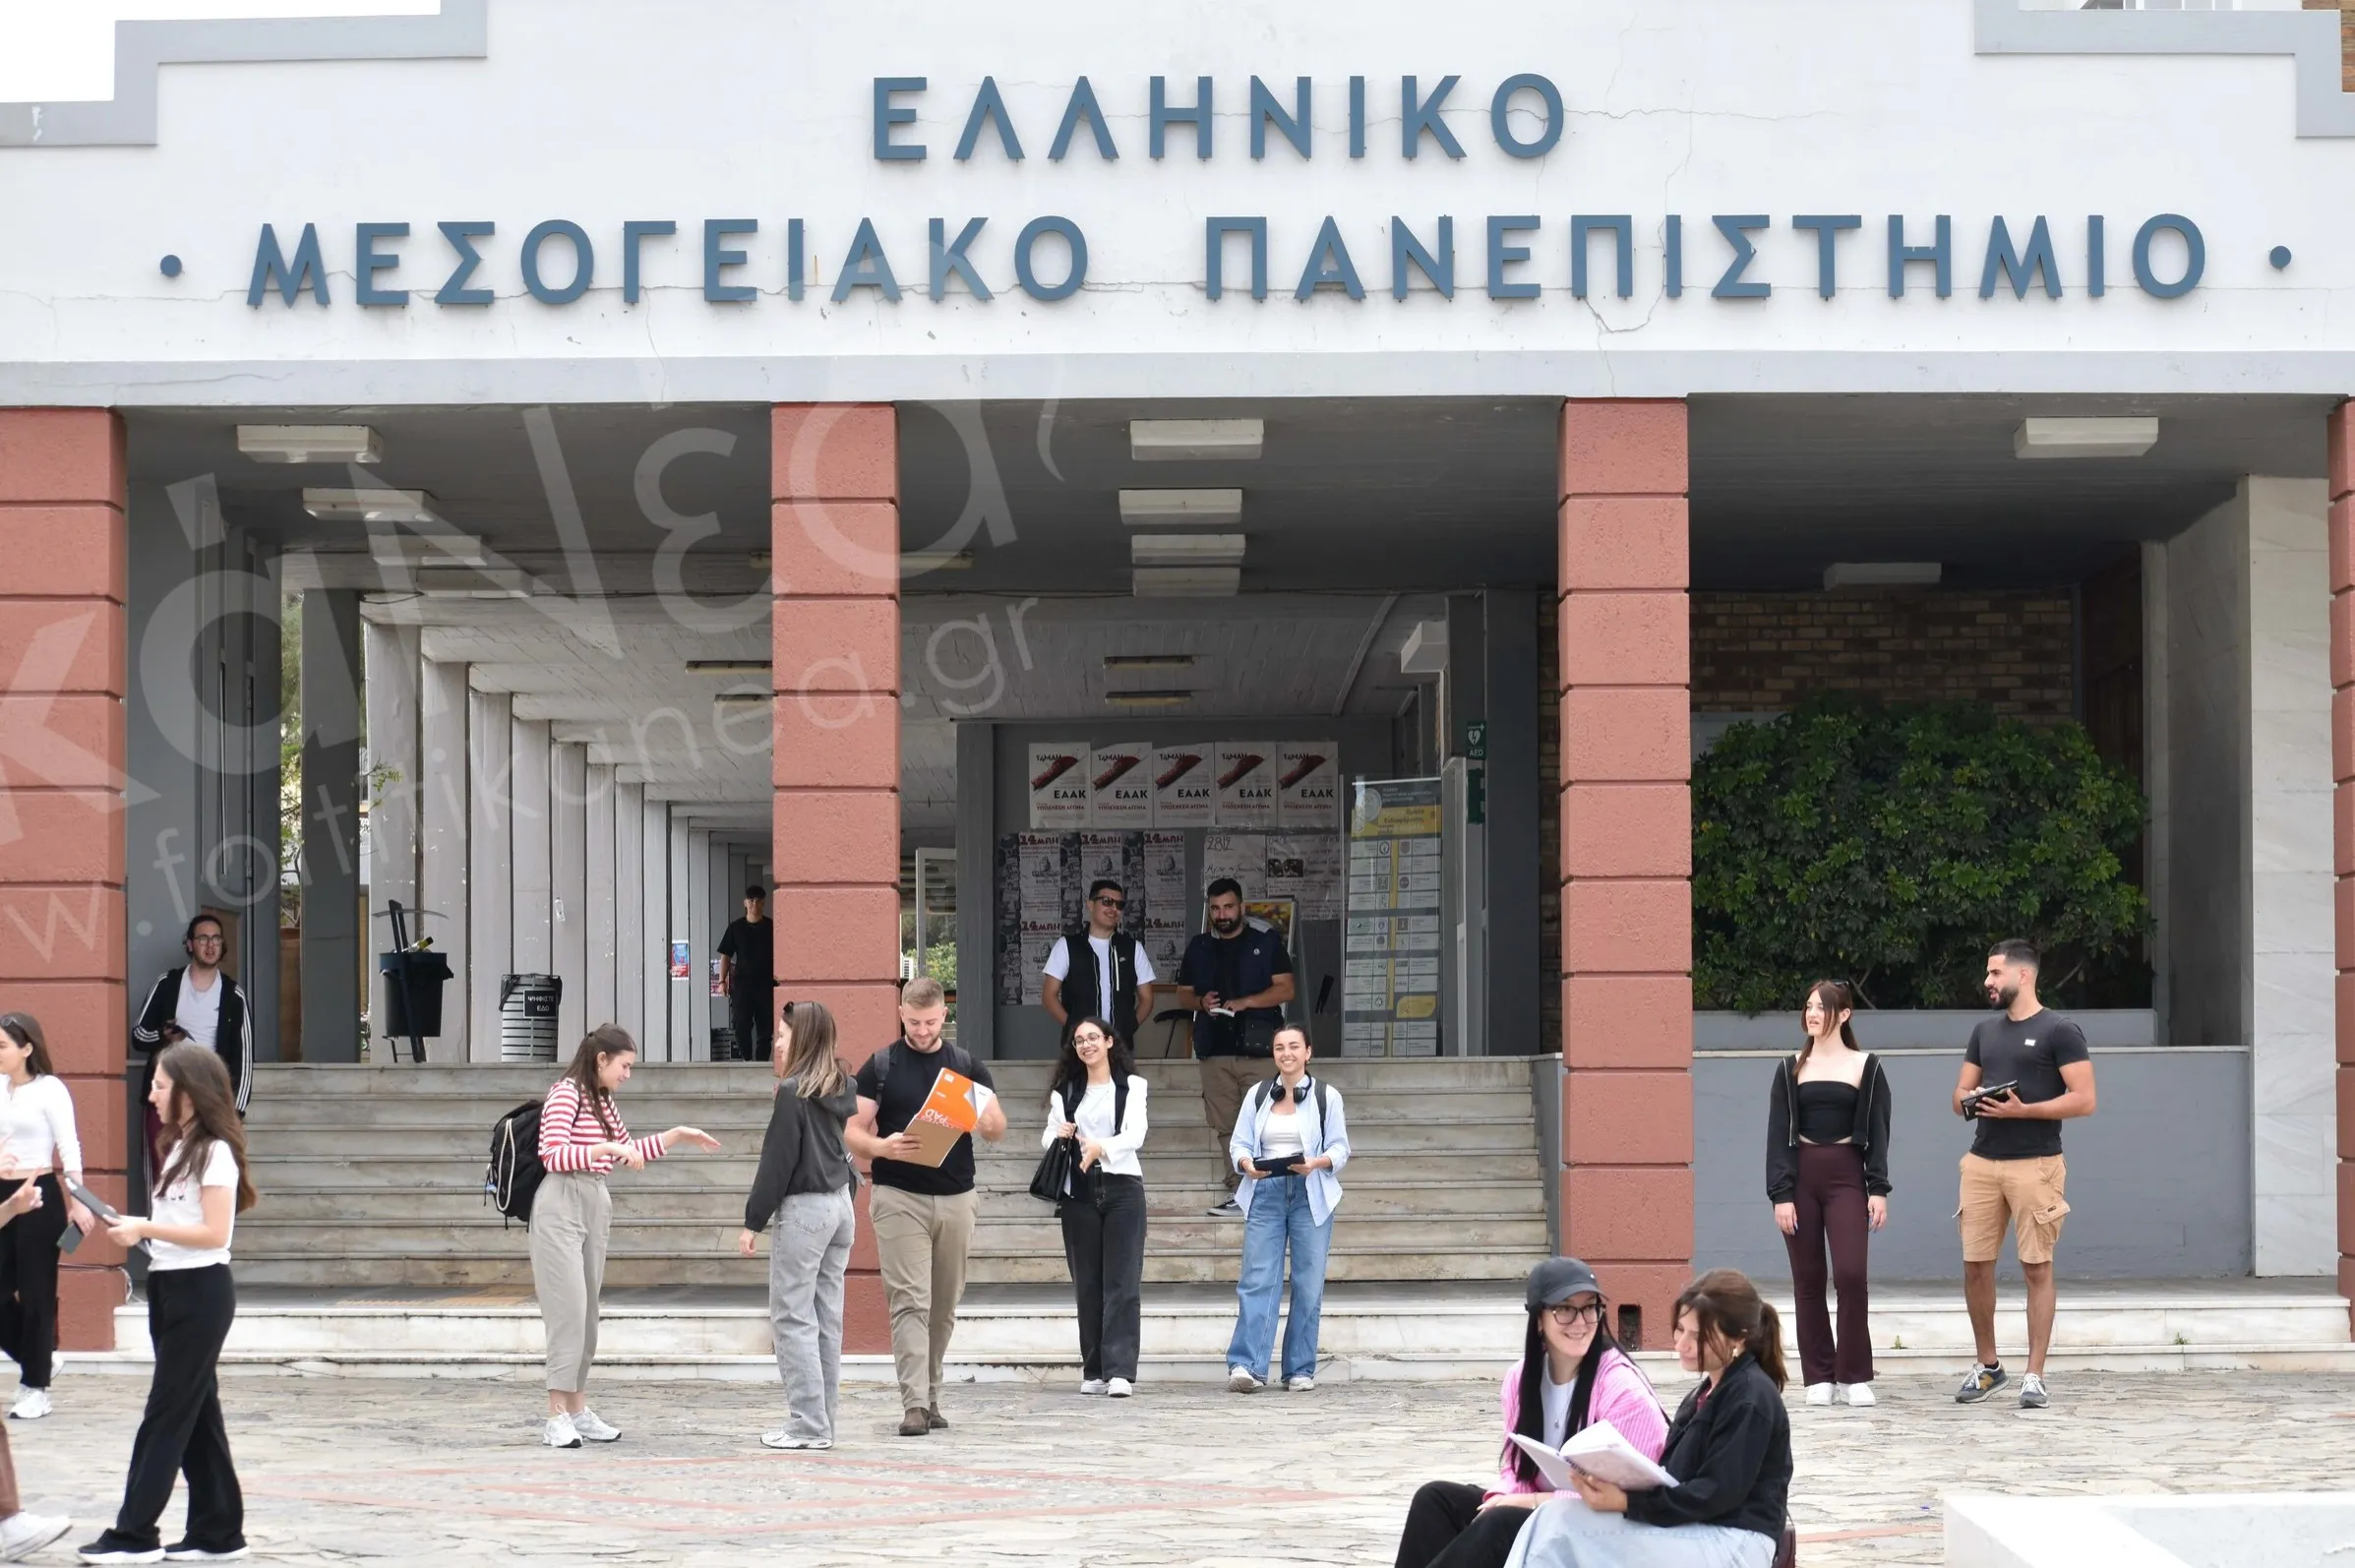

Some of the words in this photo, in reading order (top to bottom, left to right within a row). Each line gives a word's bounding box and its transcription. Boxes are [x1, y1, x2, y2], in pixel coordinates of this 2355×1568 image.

[874, 73, 1564, 160] ΕΛΛΗΝΙΚΟ
[247, 214, 1089, 307] ΜΕΣΟΓΕΙΑΚΟ
[1206, 213, 2206, 301] ΠΑΝΕΠΙΣΤΗΜΙΟ
[1054, 790, 1087, 799] ΕΑΑΚ
[1116, 790, 1148, 799] ΕΑΑΚ
[1178, 788, 1210, 798] ΕΑΑΚ
[1239, 788, 1272, 798] ΕΑΑΚ
[1300, 789, 1334, 798] ΕΑΑΚ
